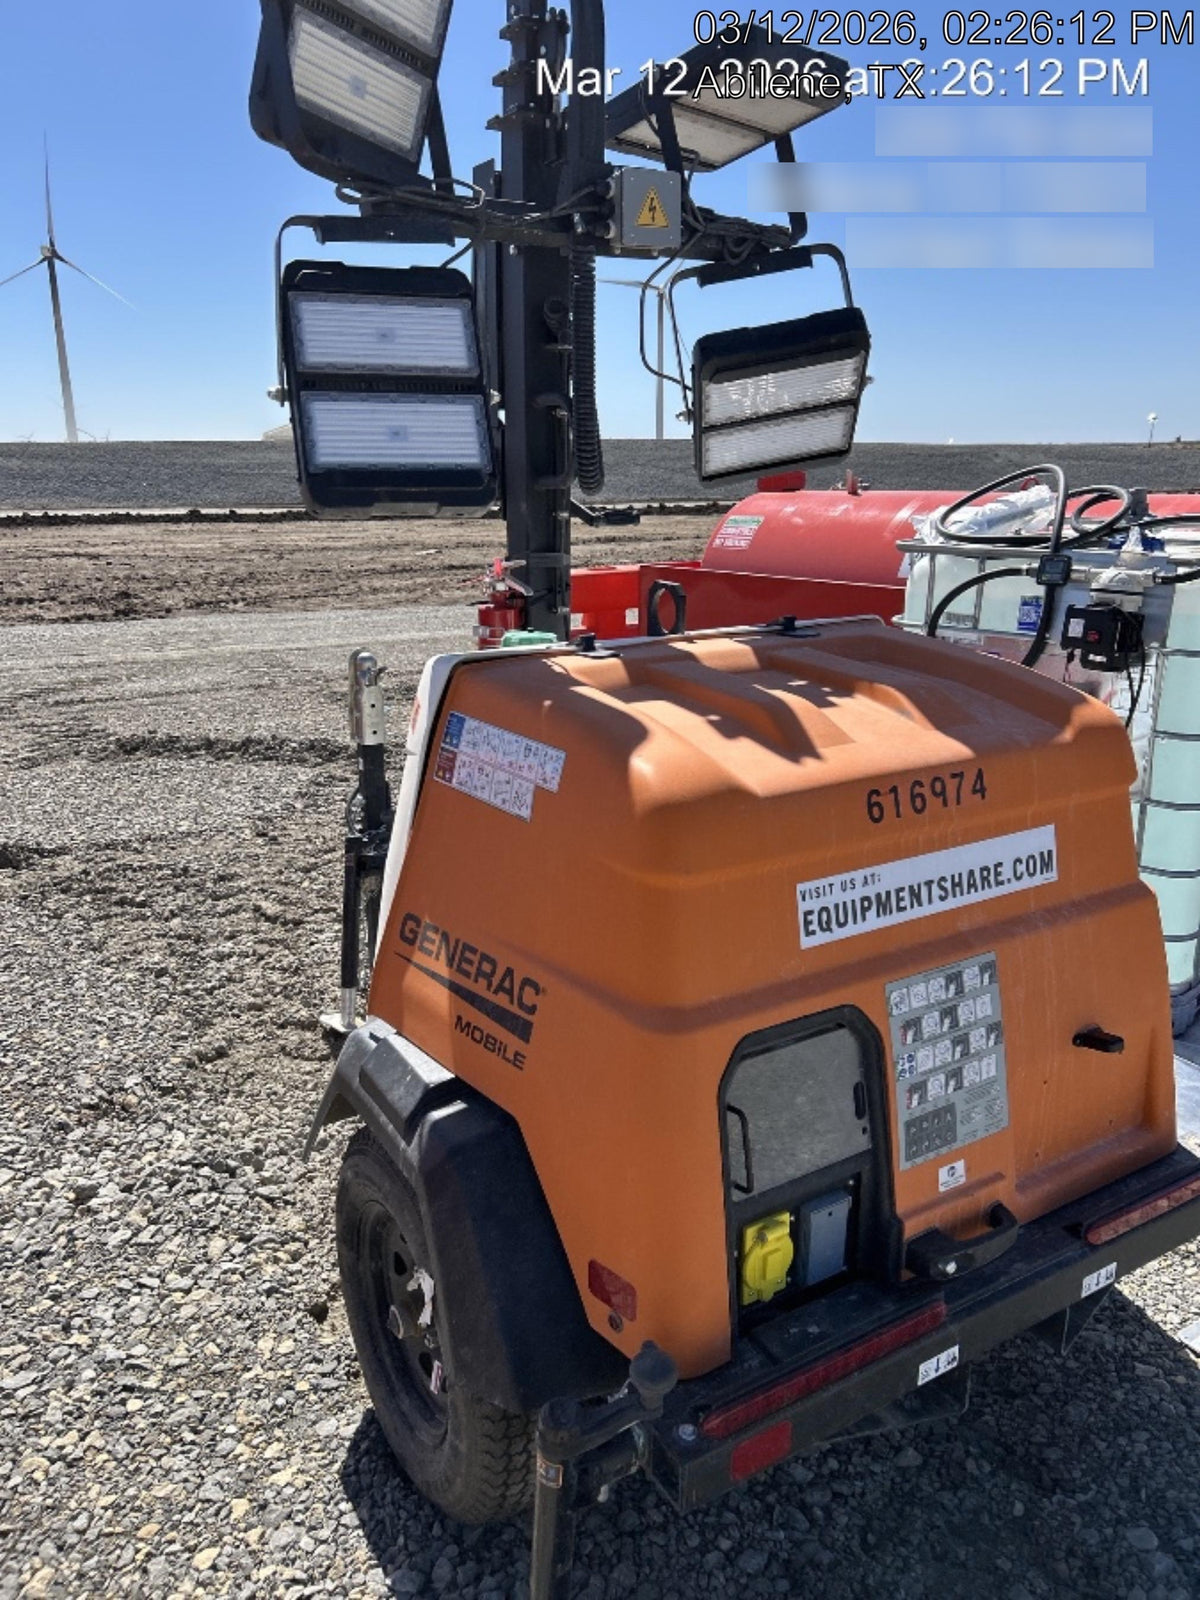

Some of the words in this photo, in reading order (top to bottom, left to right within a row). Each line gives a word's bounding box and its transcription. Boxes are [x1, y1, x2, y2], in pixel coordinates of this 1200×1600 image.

[866, 768, 987, 824] 616974
[799, 882, 835, 902] VISIT
[840, 877, 857, 894] US
[861, 872, 882, 889] AT:
[803, 848, 1054, 938] EQUIPMENTSHARE.COM
[399, 911, 541, 1017] GENERAC
[454, 1014, 527, 1071] MOBILE
